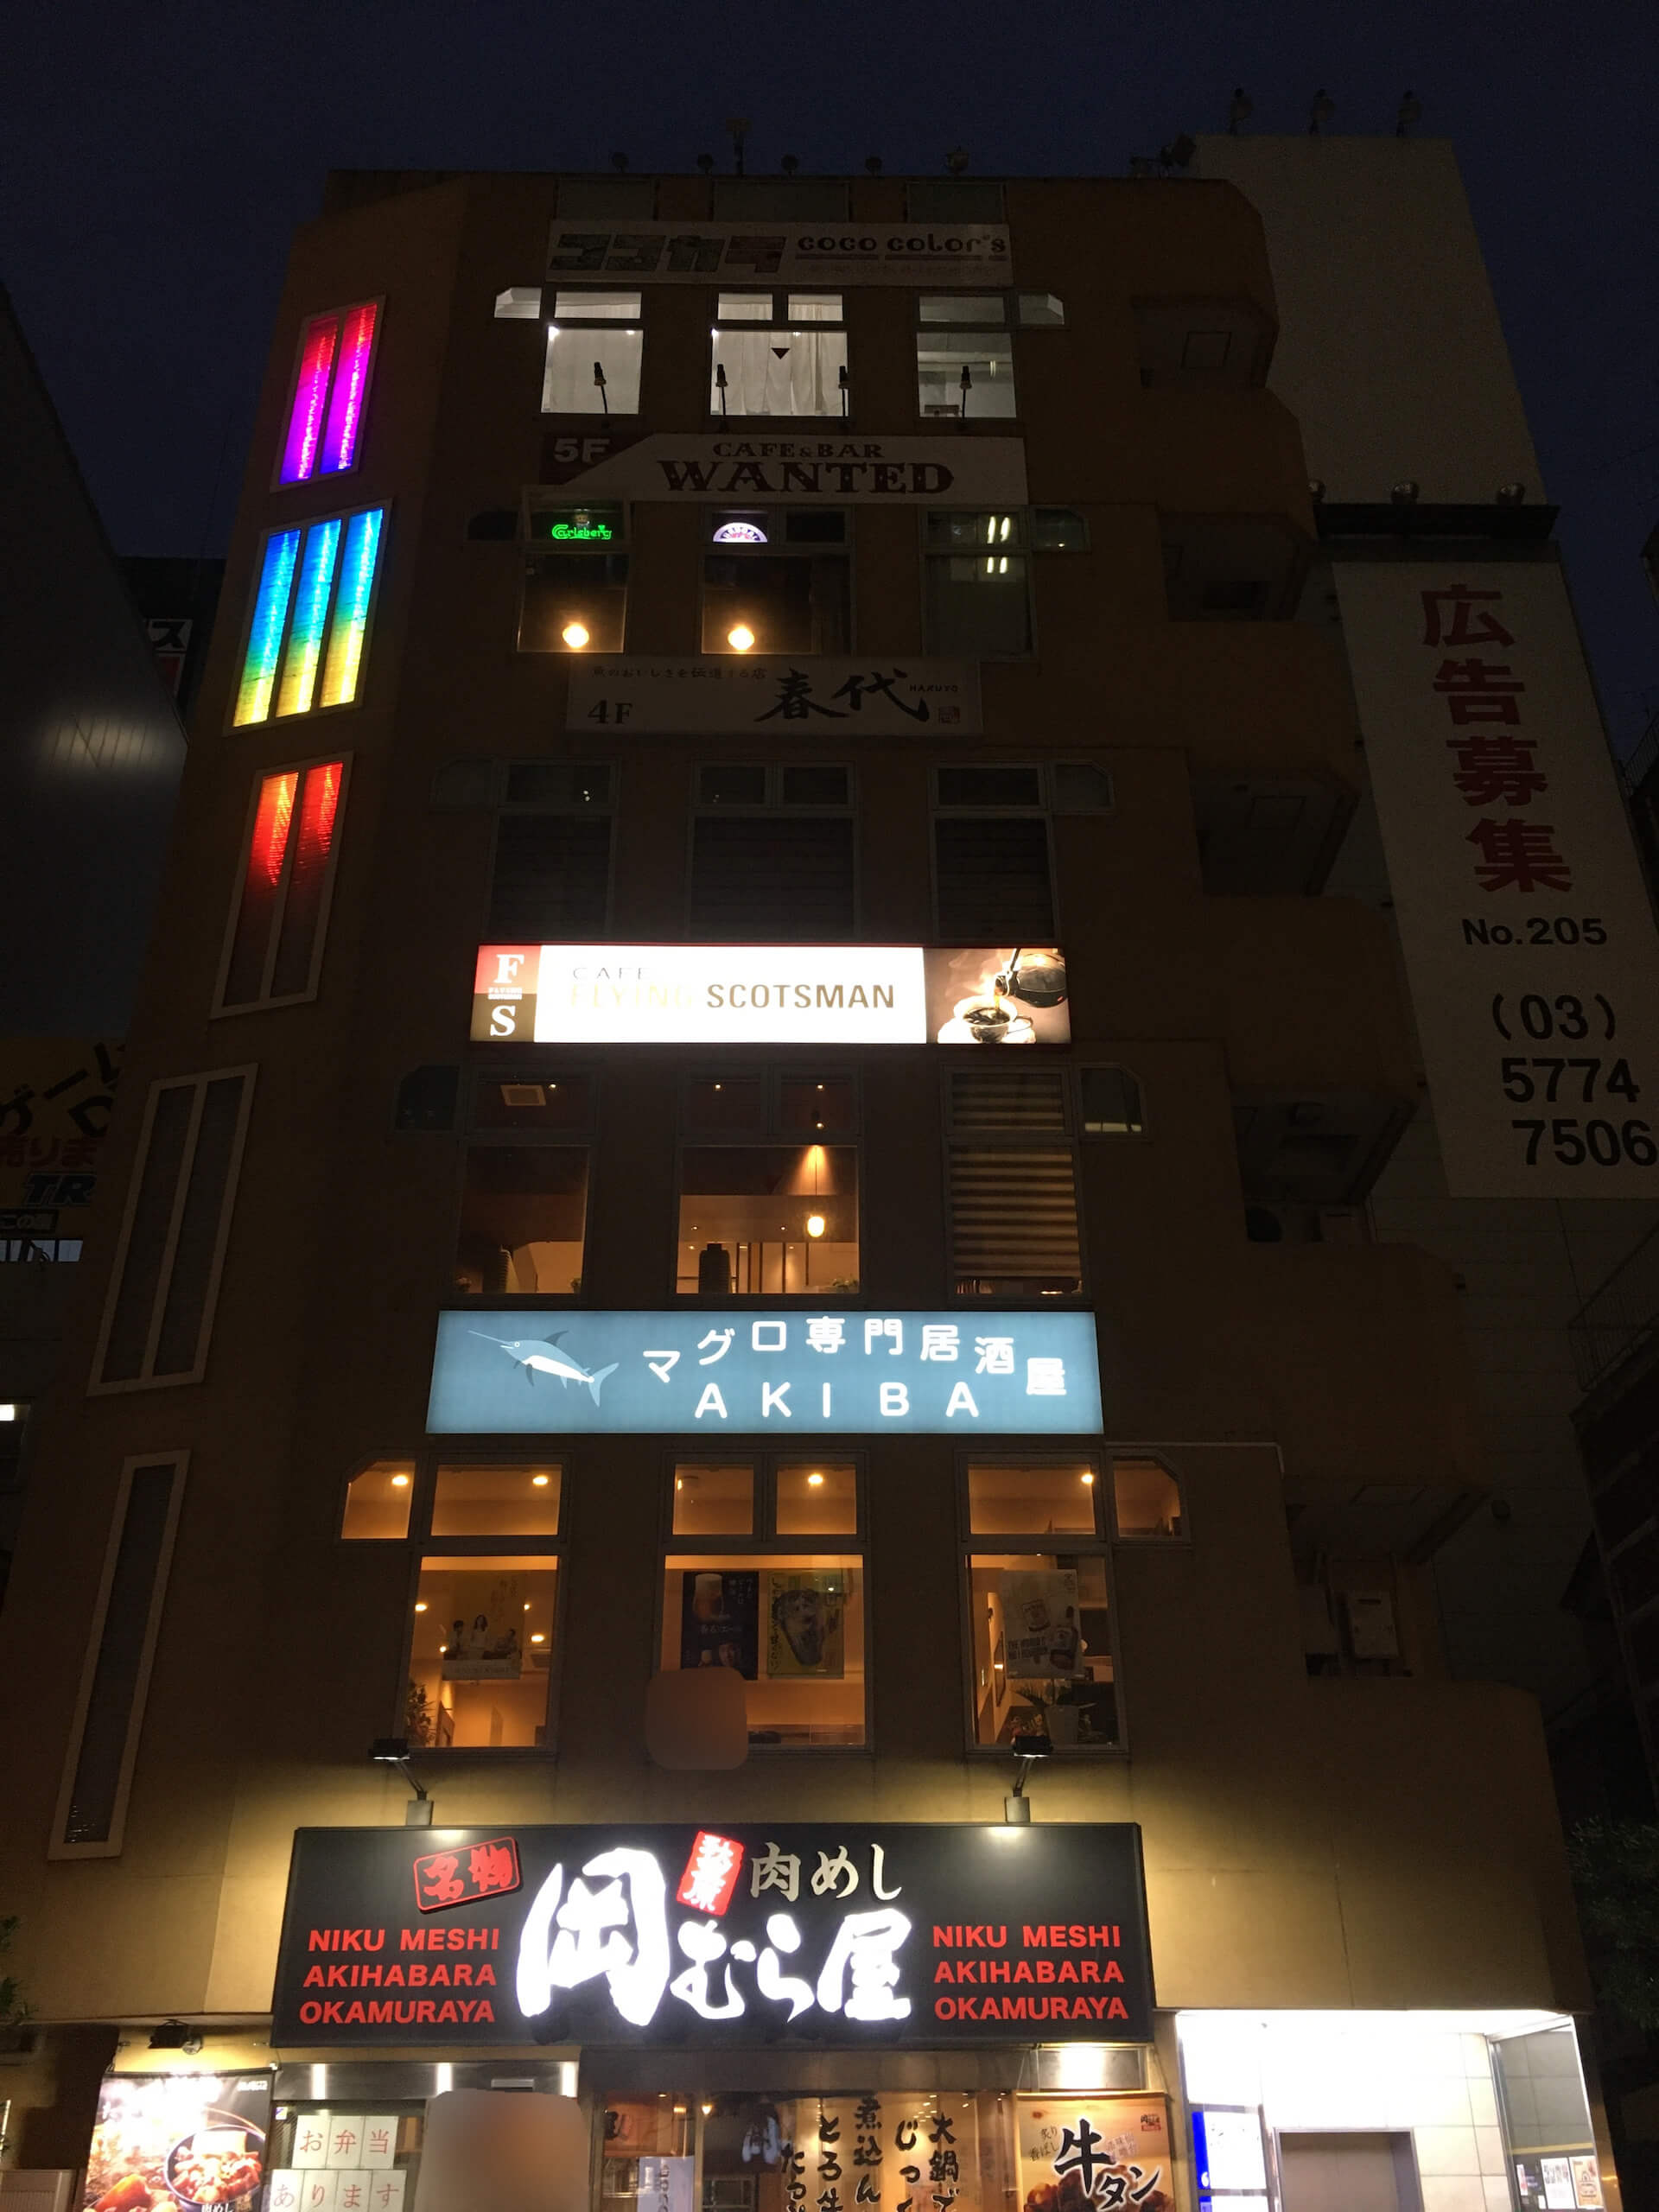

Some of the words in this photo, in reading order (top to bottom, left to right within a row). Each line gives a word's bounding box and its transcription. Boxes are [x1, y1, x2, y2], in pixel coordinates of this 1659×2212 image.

[798, 236, 878, 251] coco
[553, 439, 612, 463] 5F
[657, 460, 955, 494] WANTED
[551, 524, 613, 540] Carlsberg
[753, 665, 931, 722] 春代
[587, 699, 633, 724] 4F
[1421, 583, 1573, 893] 広告募集
[1462, 916, 1608, 945] No.205
[705, 983, 895, 1009] SCOTSMAN
[1492, 993, 1616, 1040] (03)
[1501, 1057, 1641, 1103] 5774
[1511, 1118, 1657, 1166] 7506
[642, 1316, 1068, 1397] マグロ専門居酒屋
[694, 1382, 980, 1419] AKIBA
[749, 1840, 902, 1903] 肉めし
[308, 1929, 385, 1952] NIKU
[399, 1928, 499, 1951] MESHI
[516, 1847, 912, 2027] 岡むら屋
[932, 1926, 1007, 1948] NIKU
[1022, 1925, 1121, 1948] MESHI
[303, 1964, 497, 1987] AKIHABARA
[934, 1961, 1124, 1984] AKIHABARA
[299, 2001, 495, 2024] OKAMURAYA
[934, 1997, 1128, 2020] OKAMURAYA
[298, 2129, 390, 2155] お弁当
[1053, 2117, 1160, 2212] 牛タン
[272, 2186, 401, 2209] あります
